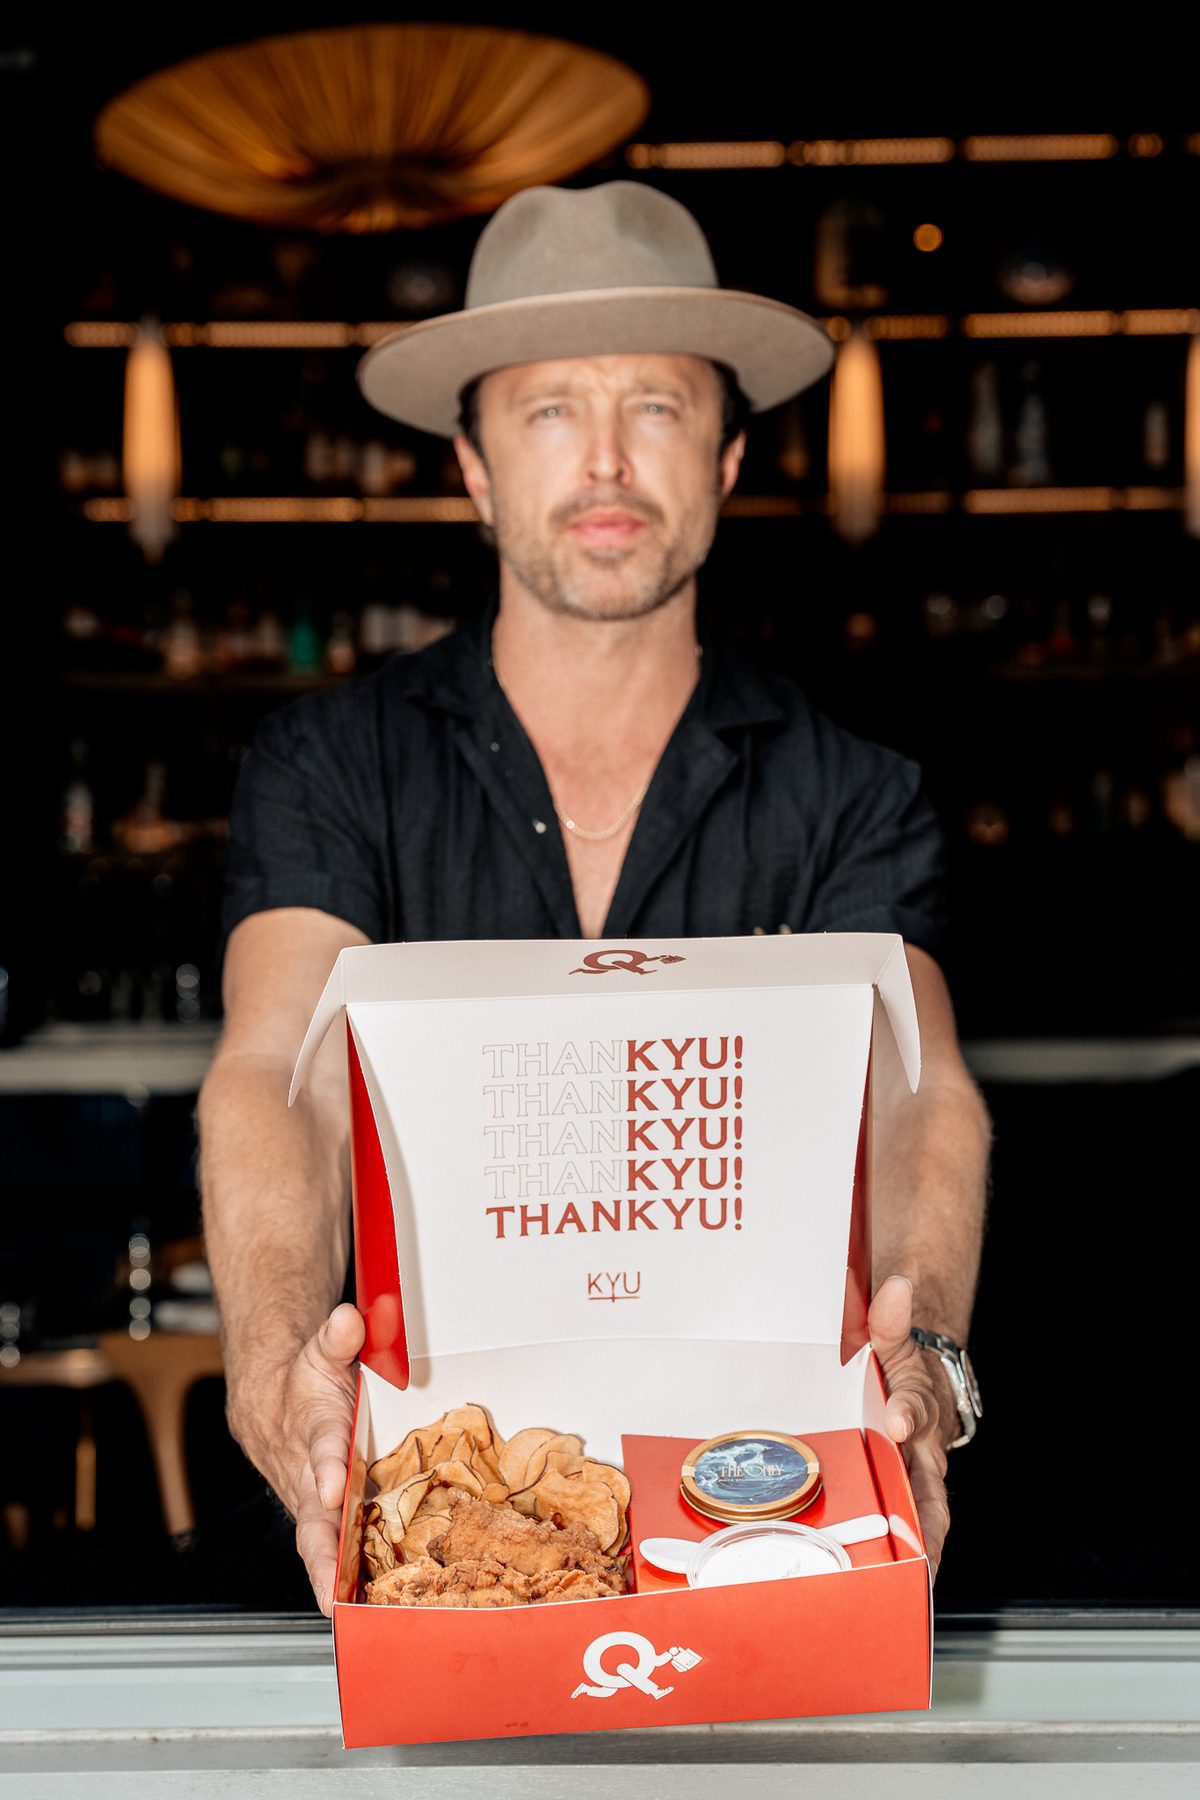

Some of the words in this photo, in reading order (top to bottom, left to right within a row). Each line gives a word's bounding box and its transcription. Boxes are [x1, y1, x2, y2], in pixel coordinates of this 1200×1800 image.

[482, 1035, 743, 1078] THANKYU!
[482, 1075, 743, 1118] THANKYU!
[483, 1116, 743, 1159] THANKYU!
[484, 1156, 743, 1199] THANKYU!
[485, 1197, 743, 1239] THANKYU!
[587, 1271, 641, 1303] KYU
[720, 1464, 743, 1477] THE
[746, 1463, 785, 1477] ONLY
